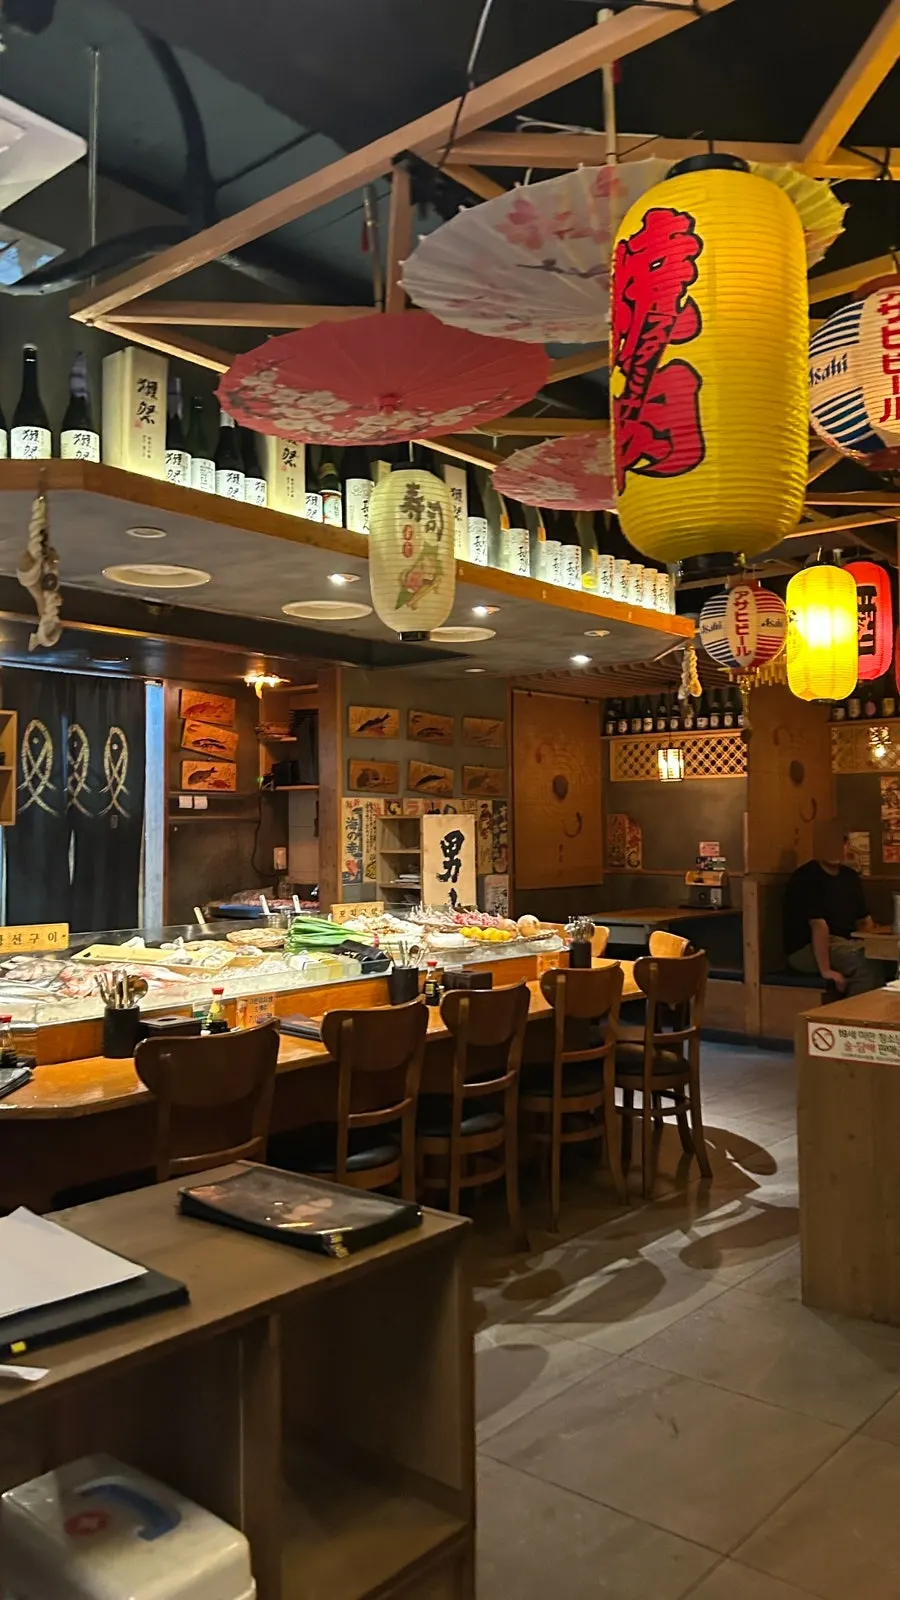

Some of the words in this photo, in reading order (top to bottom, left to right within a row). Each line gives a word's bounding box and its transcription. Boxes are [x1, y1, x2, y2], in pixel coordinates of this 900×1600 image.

[733, 590, 752, 656] アサヒビール
